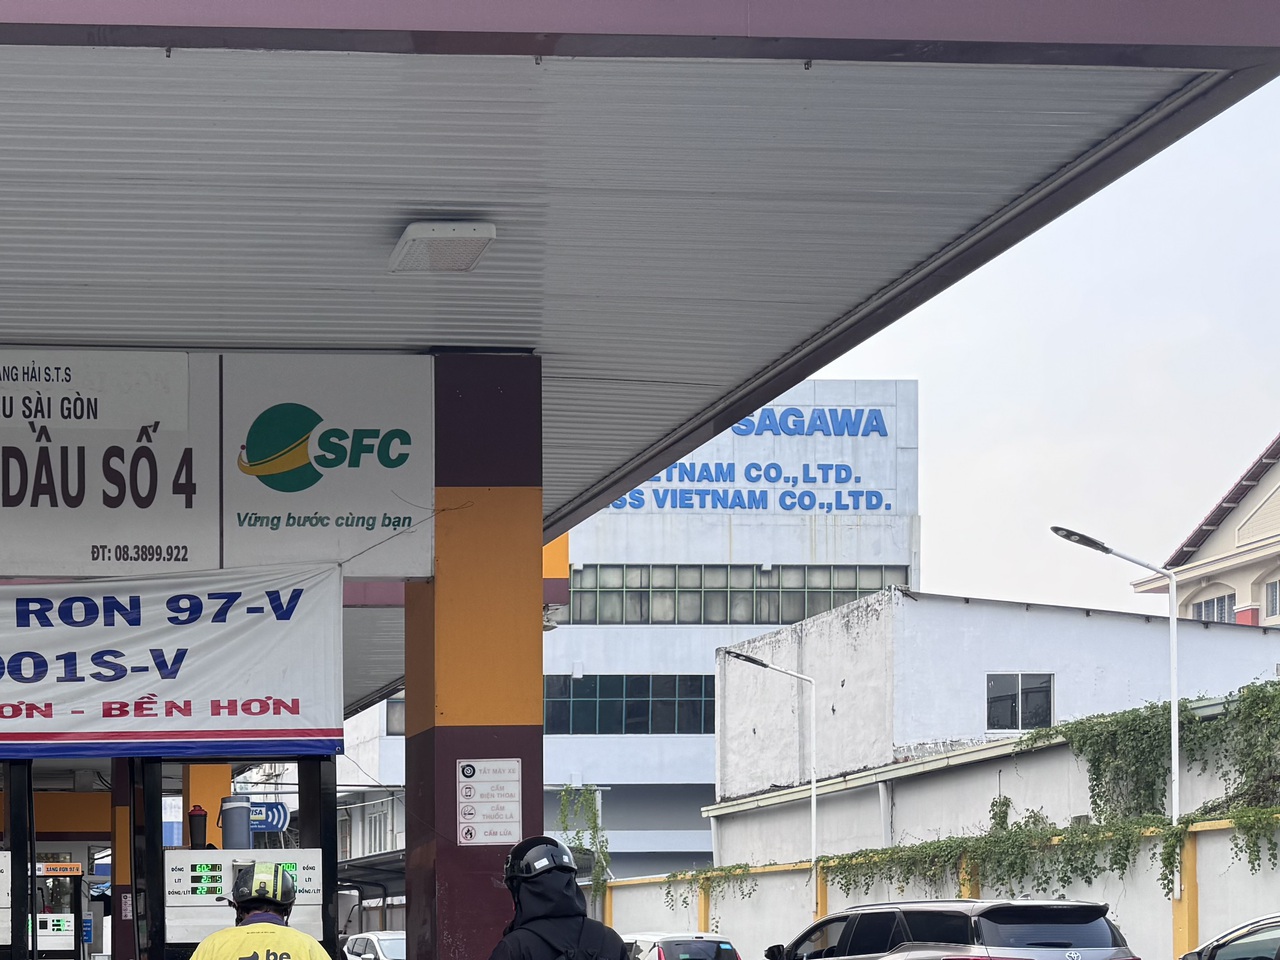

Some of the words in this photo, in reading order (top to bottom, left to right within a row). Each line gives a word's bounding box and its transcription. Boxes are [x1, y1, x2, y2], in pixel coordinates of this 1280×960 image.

[22, 360, 41, 382] HẢI
[44, 366, 72, 383] S.T.S
[21, 390, 52, 419] SÀI
[60, 391, 99, 420] GÒN
[731, 407, 888, 437] SAGAWA
[314, 428, 412, 468] SFC
[1, 420, 87, 510] DẦU
[101, 420, 162, 510] SỐ
[171, 446, 197, 510] 4
[648, 462, 736, 483] TNAM
[652, 489, 768, 509] VIETNAM
[237, 512, 281, 531] Vững
[285, 512, 330, 528] bước
[334, 512, 376, 531] cùng
[381, 512, 412, 531] bạn
[91, 544, 111, 561] ĐT:
[114, 544, 189, 562] 08.3899.922
[15, 594, 142, 628] RON
[165, 588, 304, 626] 97-V
[102, 693, 193, 718] BỀN
[210, 694, 301, 717] HƠN
